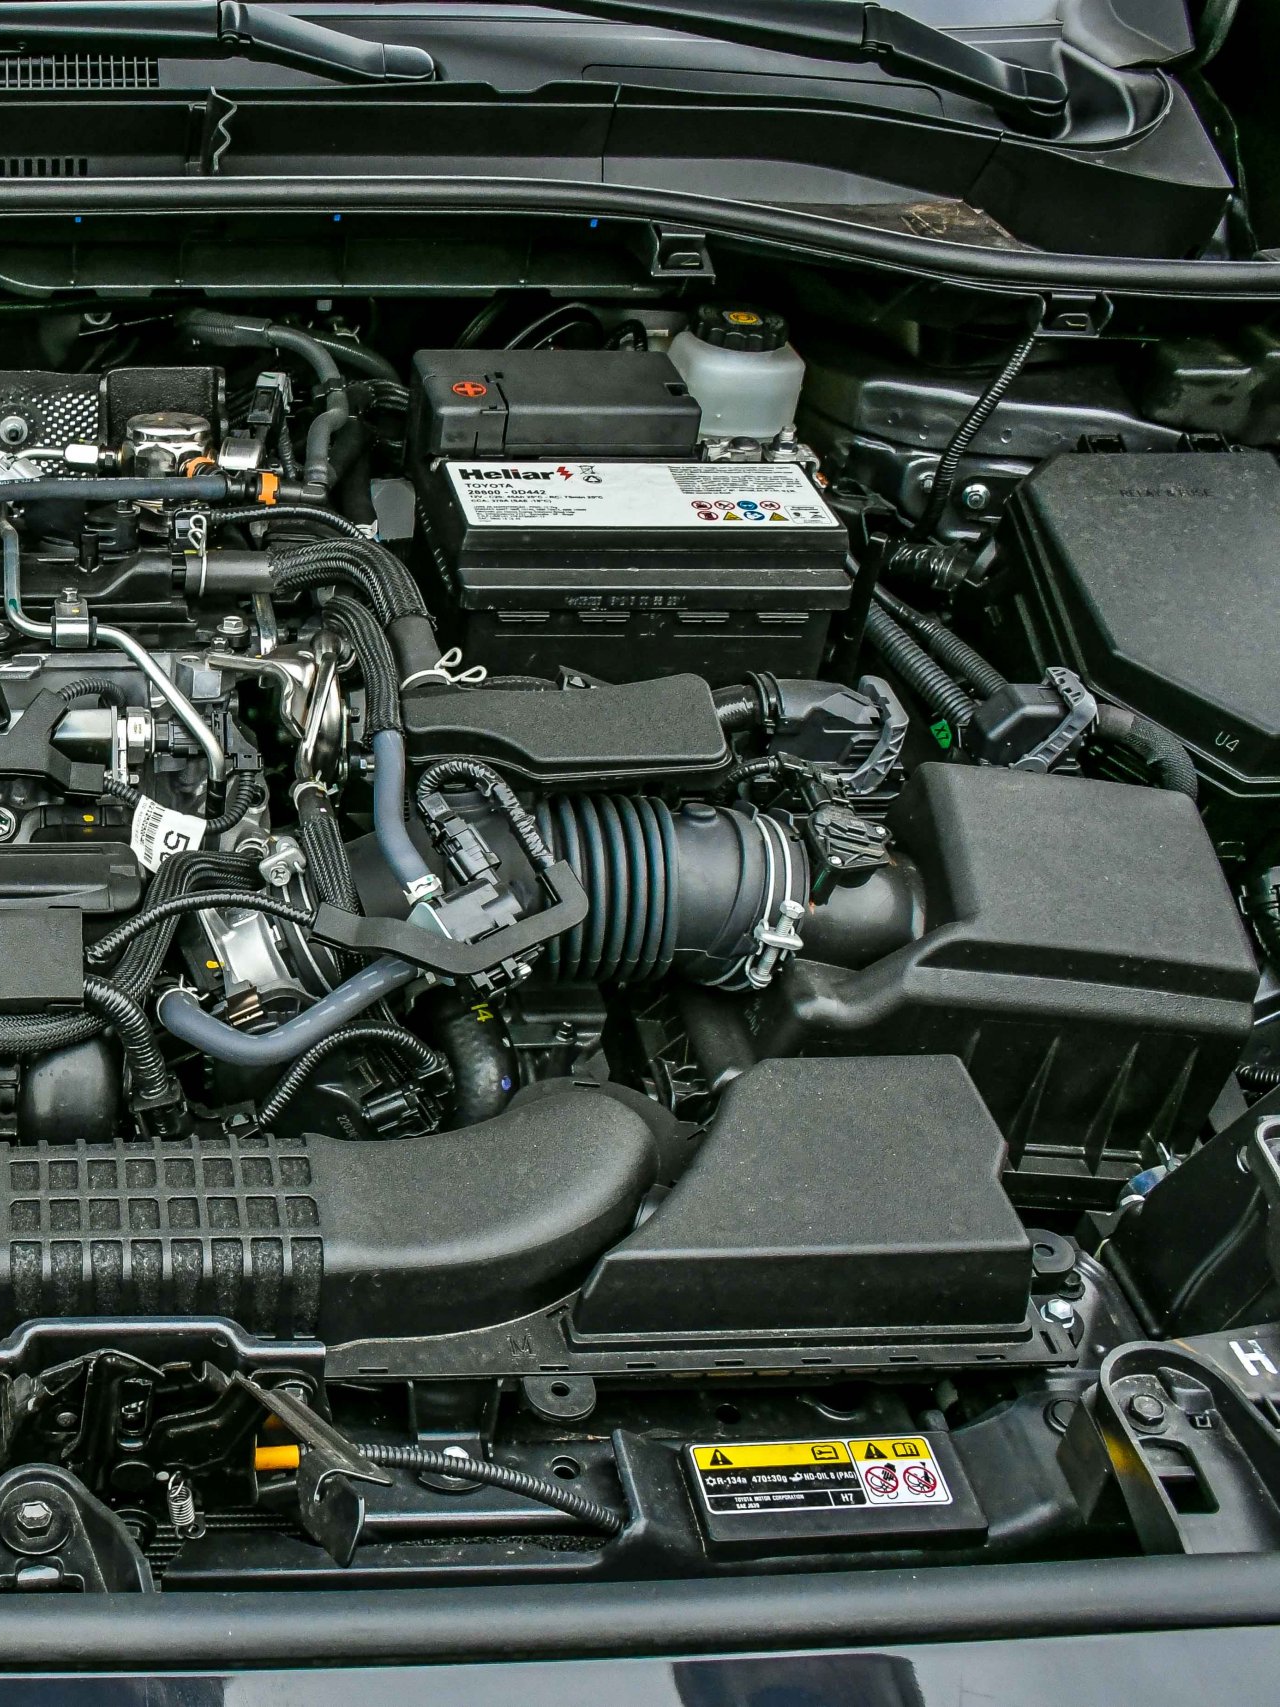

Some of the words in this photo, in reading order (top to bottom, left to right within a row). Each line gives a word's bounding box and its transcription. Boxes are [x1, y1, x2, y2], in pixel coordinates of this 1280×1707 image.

[459, 468, 554, 480] Heliar
[1215, 731, 1240, 752] U4
[1228, 1339, 1279, 1376] H
[803, 1472, 830, 1481] ND-OIL
[836, 1471, 857, 1481] (PAG)
[754, 1494, 771, 1502] MOTOR
[841, 1492, 854, 1502] H7
